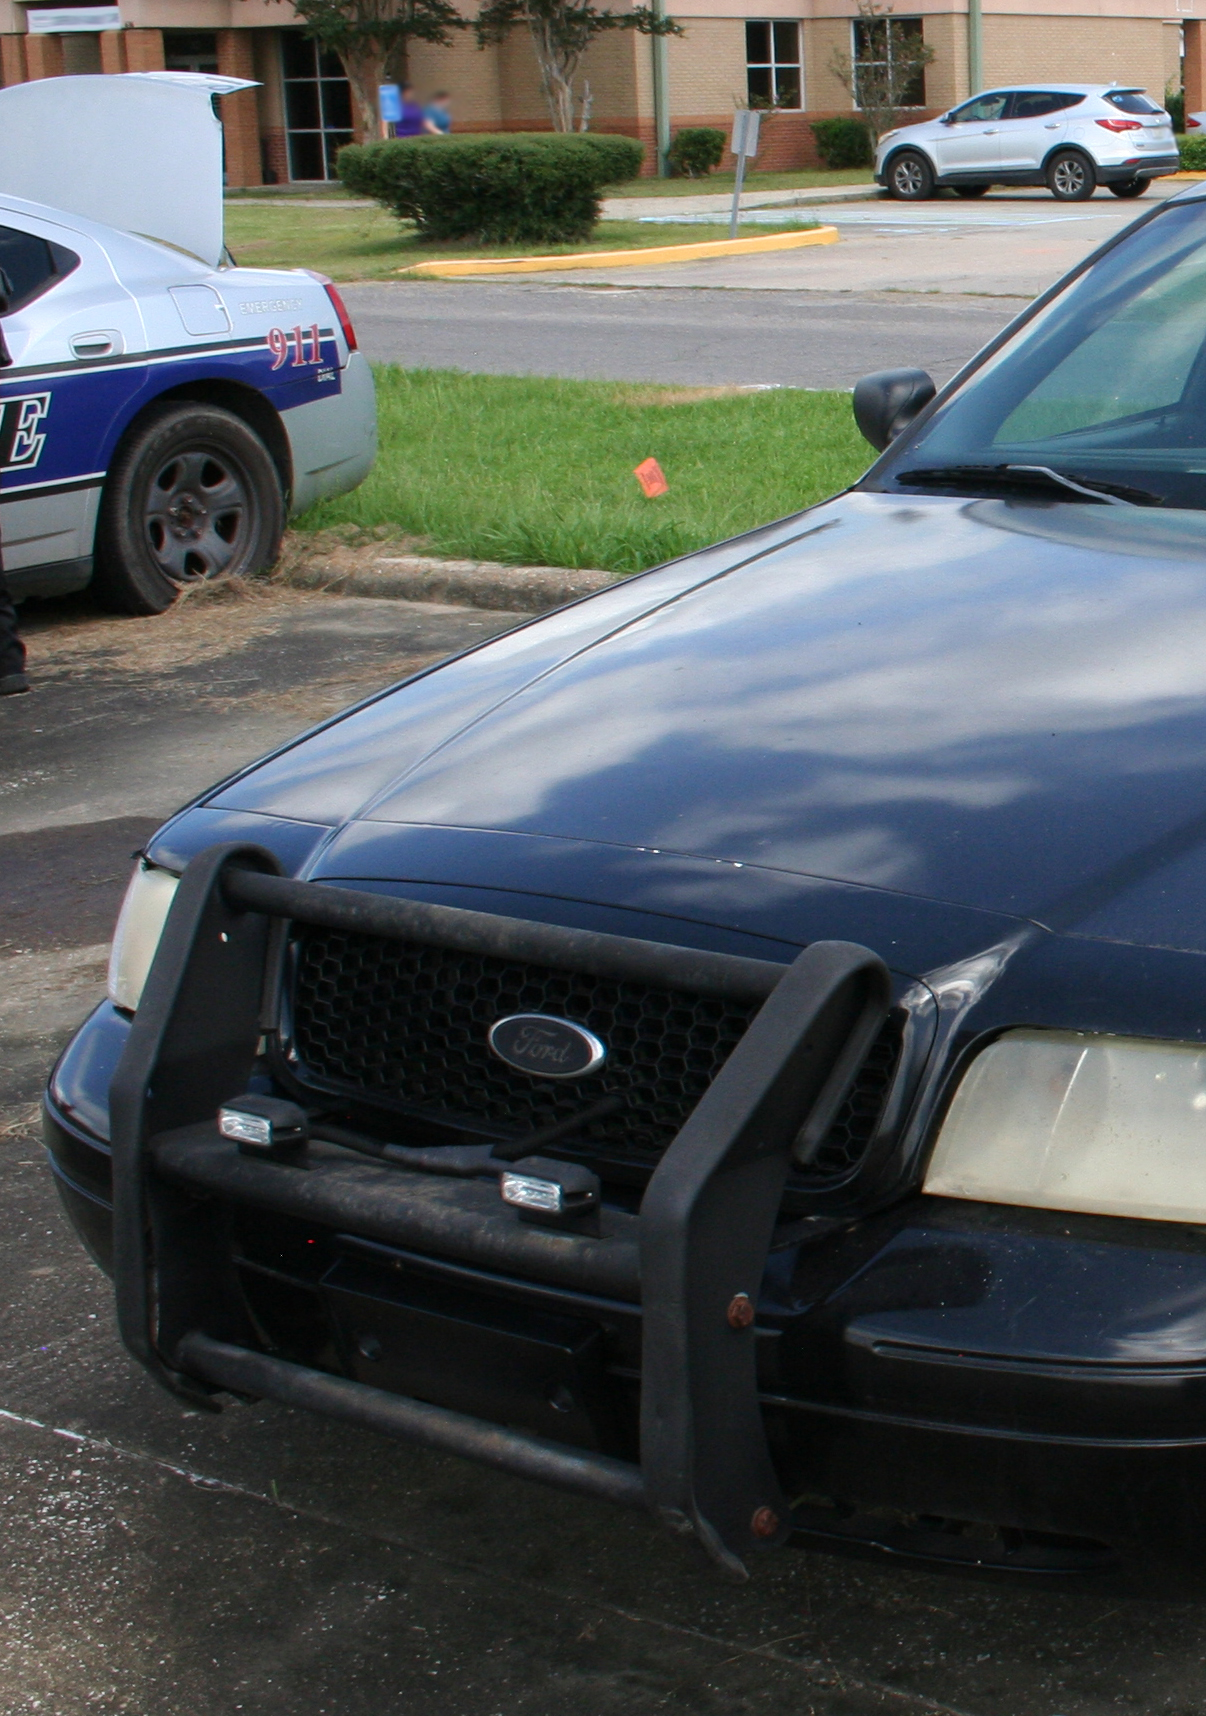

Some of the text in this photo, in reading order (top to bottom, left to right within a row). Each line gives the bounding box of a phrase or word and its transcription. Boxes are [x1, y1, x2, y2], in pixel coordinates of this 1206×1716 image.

[239, 298, 303, 315] EMERGENCY
[267, 323, 324, 371] 911
[513, 1026, 572, 1063] Ford
